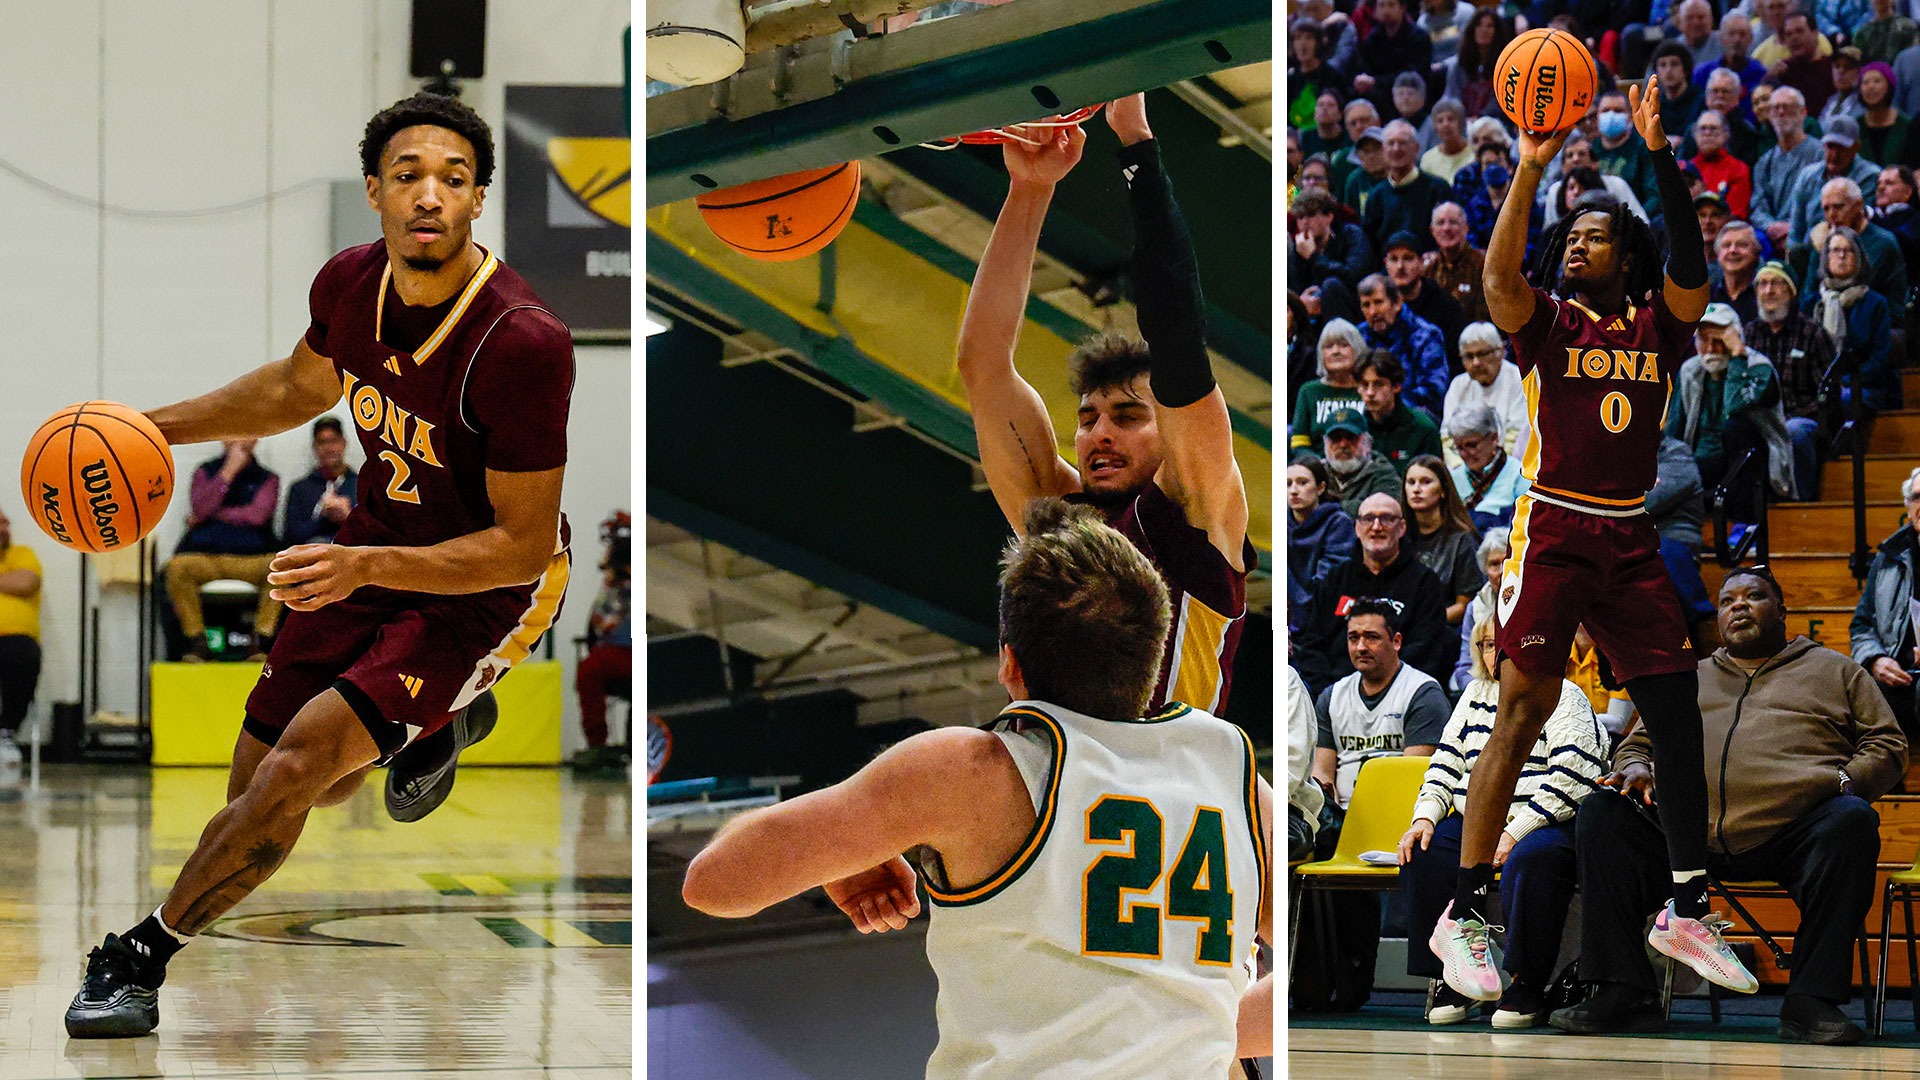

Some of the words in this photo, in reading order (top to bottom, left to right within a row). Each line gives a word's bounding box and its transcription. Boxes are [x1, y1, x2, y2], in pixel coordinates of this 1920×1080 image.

[1532, 64, 1557, 127] Wilson
[1563, 347, 1660, 383] IONA
[1600, 391, 1632, 434] 0
[81, 458, 120, 548] Wilson
[378, 450, 421, 505] 2
[1339, 733, 1403, 752] VERMONT
[1081, 793, 1235, 968] 24
